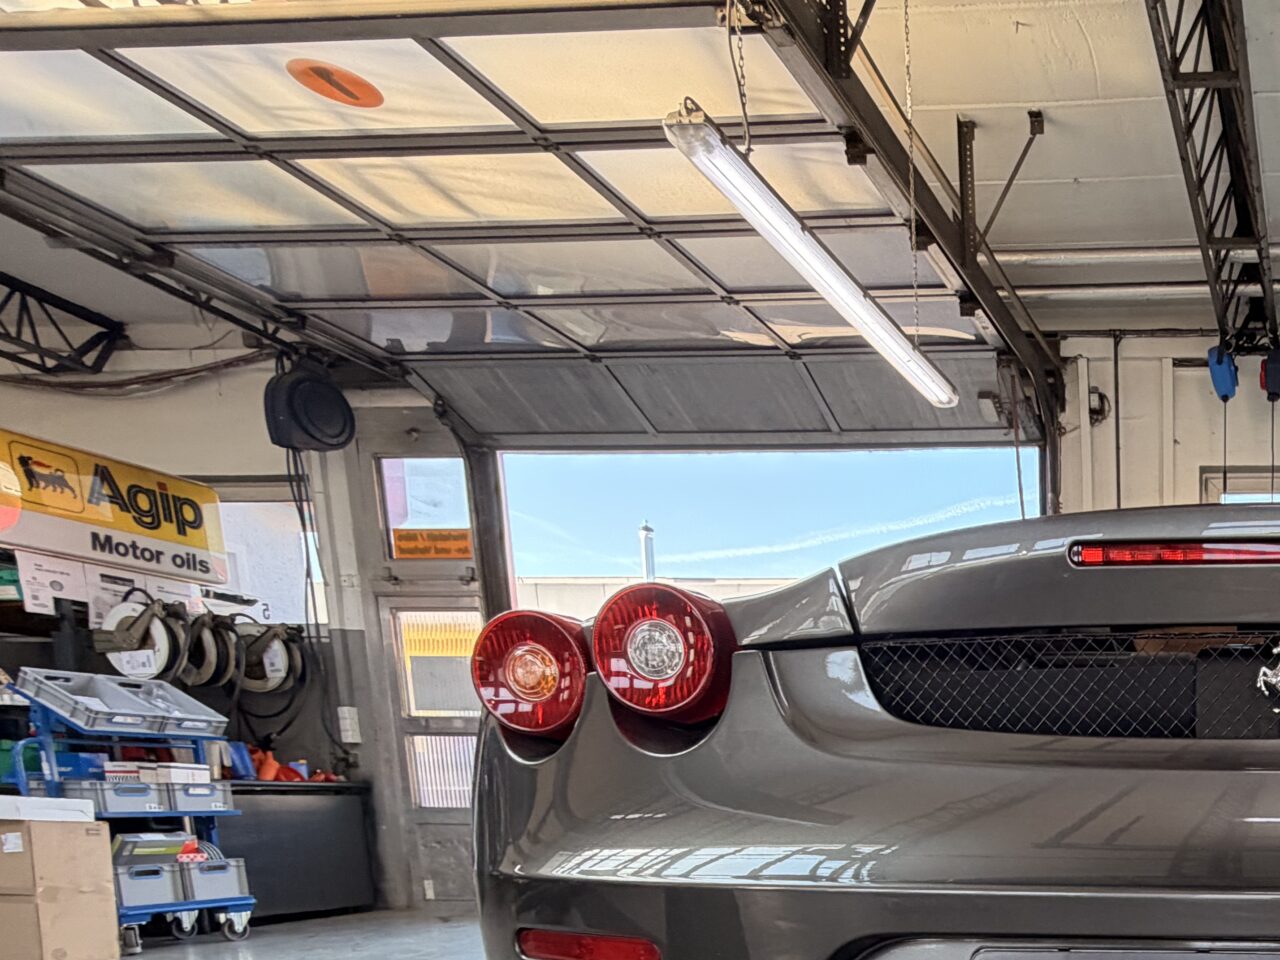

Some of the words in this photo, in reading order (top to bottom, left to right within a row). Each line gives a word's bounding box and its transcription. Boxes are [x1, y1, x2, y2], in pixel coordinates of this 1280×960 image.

[87, 463, 204, 536] Agip
[91, 532, 164, 563] Motor
[171, 552, 211, 574] oils
